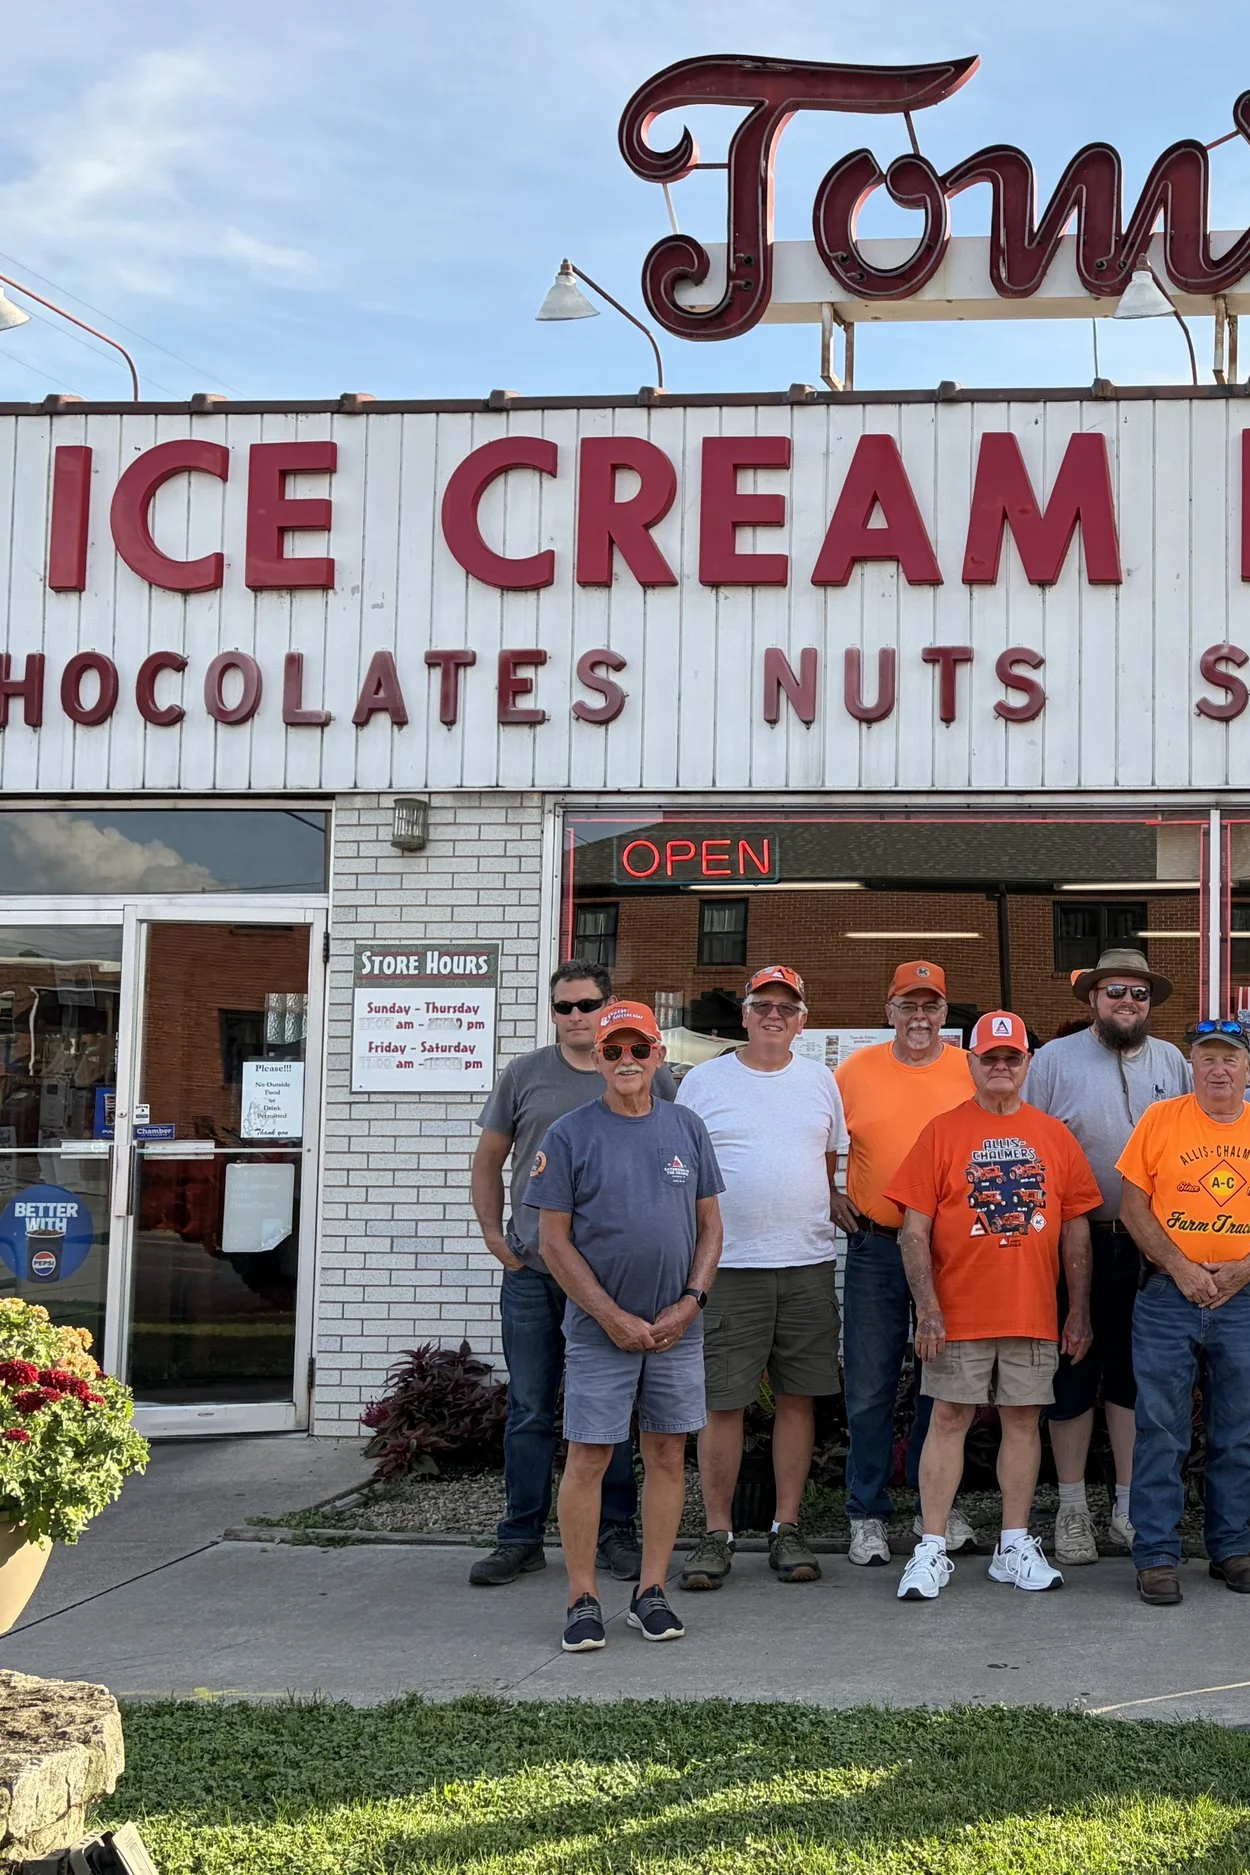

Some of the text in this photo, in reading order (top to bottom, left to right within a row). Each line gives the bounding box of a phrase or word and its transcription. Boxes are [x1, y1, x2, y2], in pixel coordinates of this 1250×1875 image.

[48, 439, 338, 593] ICE
[441, 433, 1122, 588] CREAM
[763, 645, 1046, 729] NUTS
[623, 839, 770, 878] OPEN
[367, 1002, 411, 1015] Sunday
[425, 1002, 480, 1015] Thursday
[395, 1020, 415, 1030] am
[466, 1021, 485, 1031] pm
[368, 1041, 407, 1055] Friday
[420, 1041, 476, 1055] Saturday
[255, 1064, 292, 1072] Please!!!
[395, 1060, 414, 1069] am
[464, 1060, 483, 1070] pm
[982, 1138, 1026, 1150] ALLIS-
[972, 1148, 1036, 1161] CHALMERS
[1177, 1181, 1200, 1192] Since
[1211, 1176, 1235, 1189] A-C
[14, 1202, 79, 1218] BETTER
[25, 1217, 67, 1232] WITH
[1166, 1211, 1209, 1232] Farm
